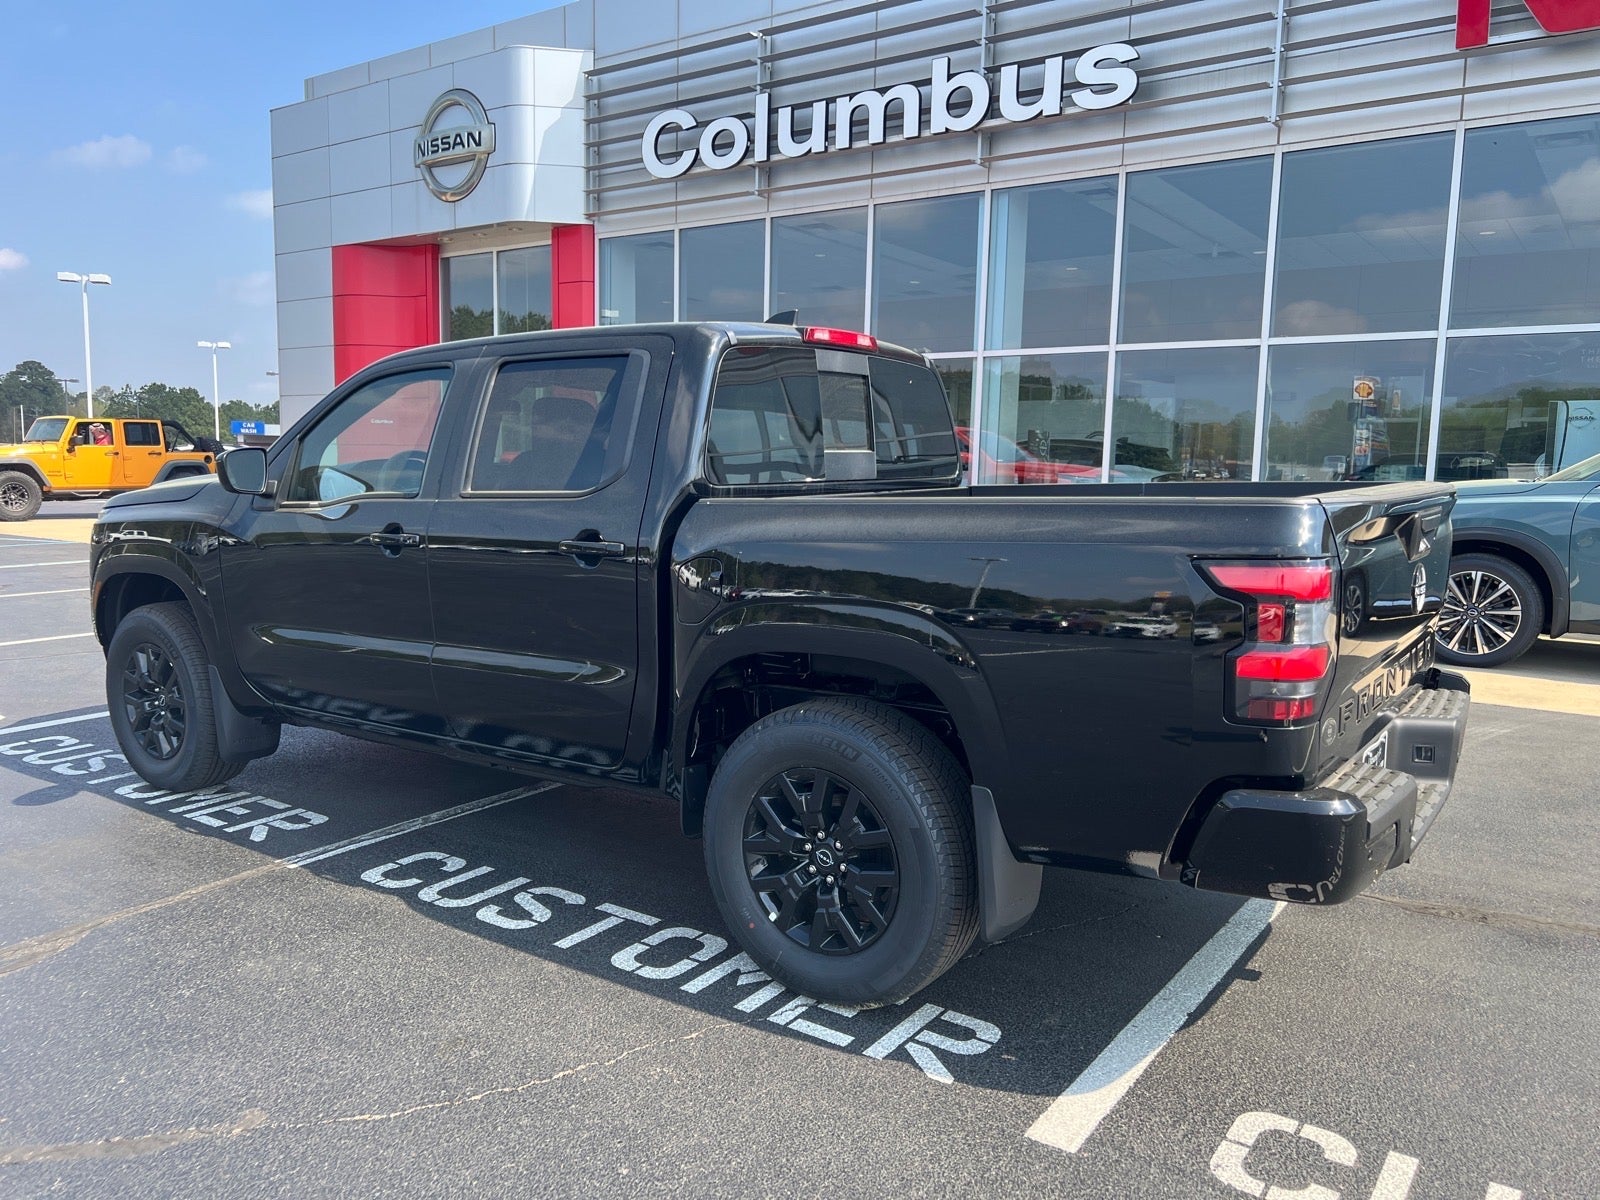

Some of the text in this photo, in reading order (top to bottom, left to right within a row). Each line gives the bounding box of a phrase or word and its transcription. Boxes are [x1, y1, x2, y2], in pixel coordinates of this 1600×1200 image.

[417, 131, 482, 160] NISSAN
[641, 43, 1139, 179] Columbus
[1337, 635, 1432, 738] FRONTIER
[360, 851, 1002, 1084] CUSTOMER
